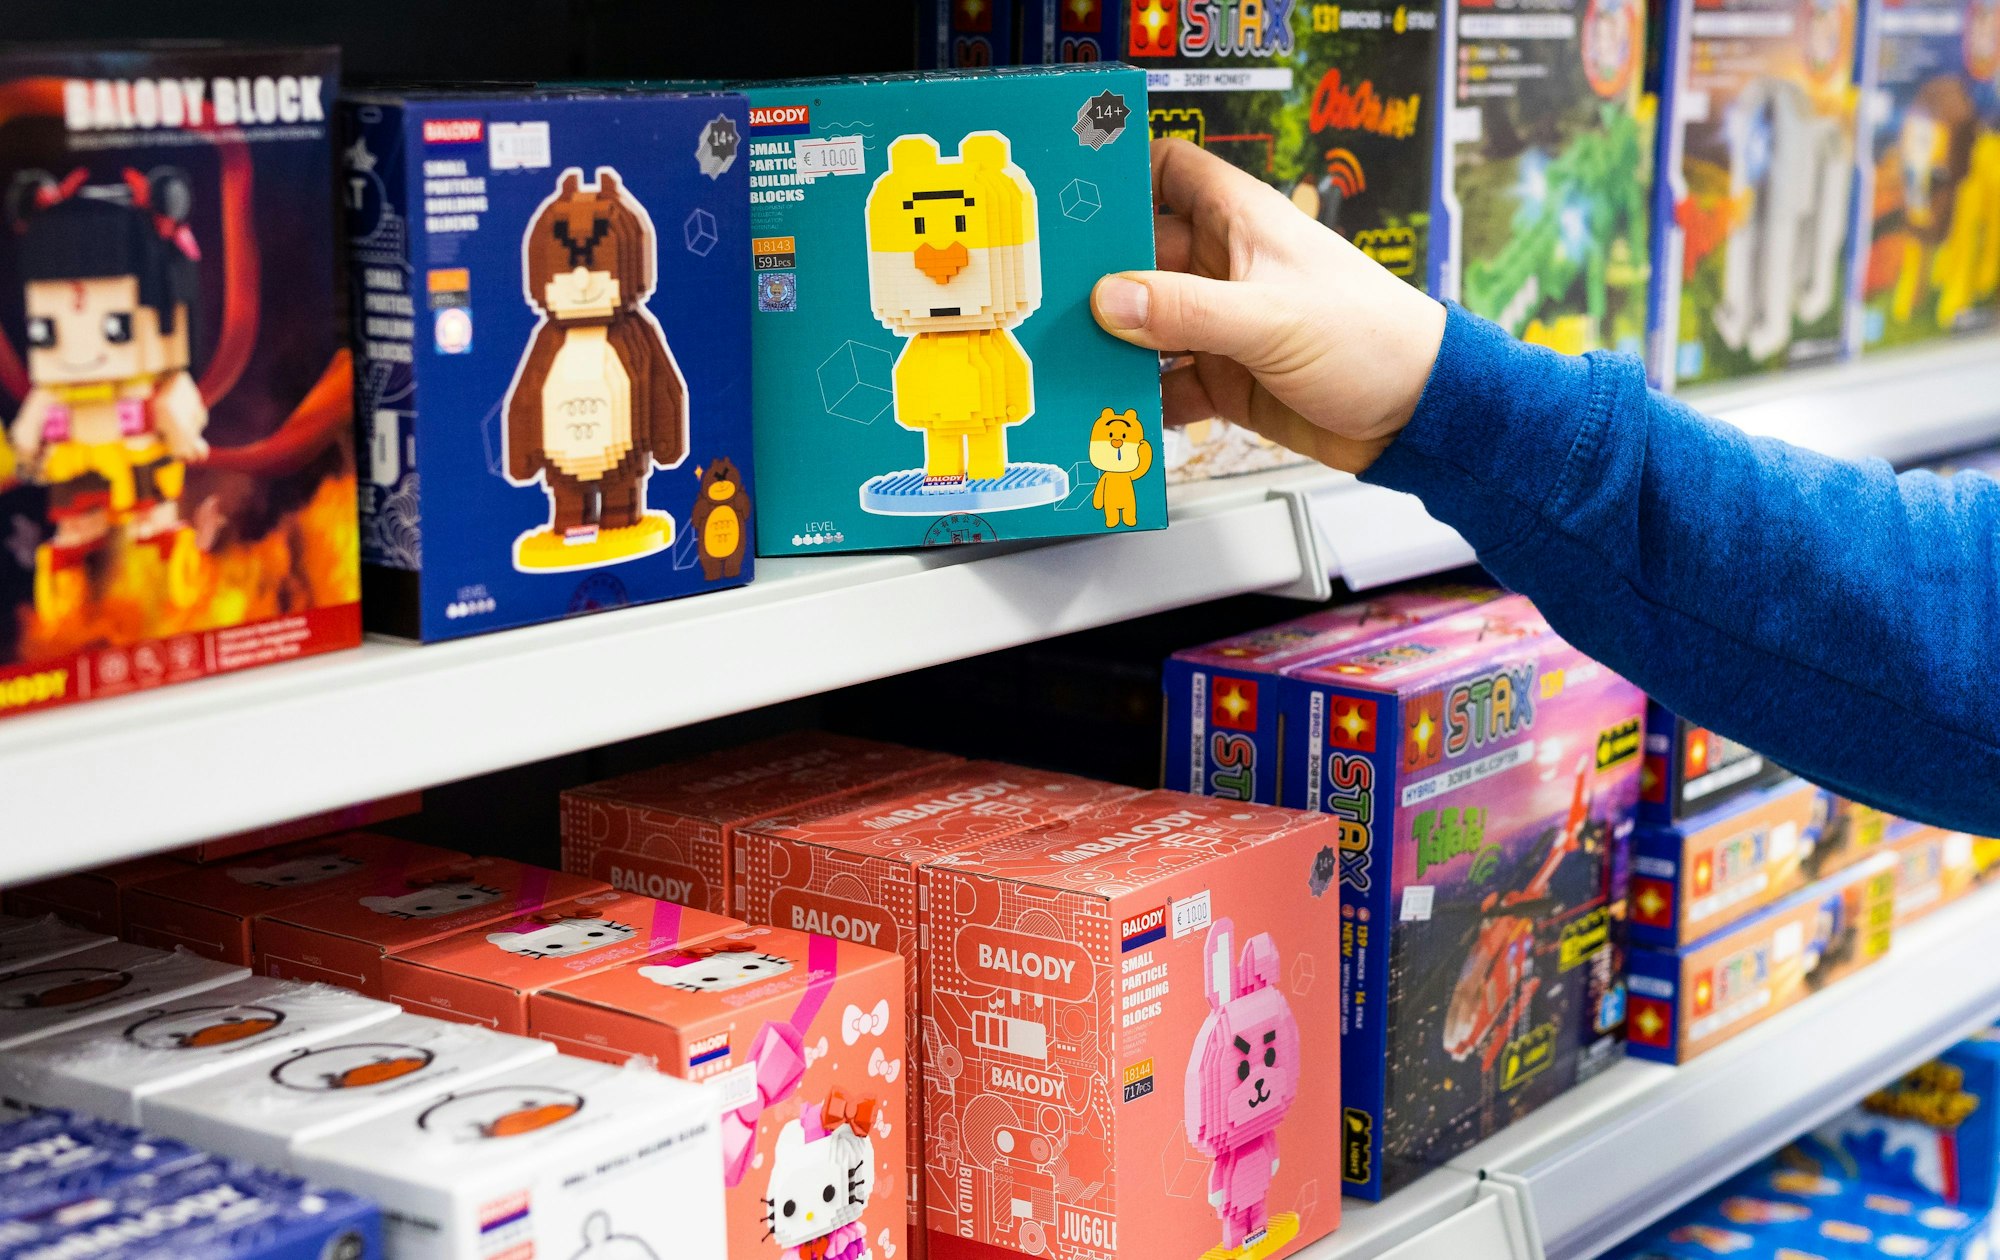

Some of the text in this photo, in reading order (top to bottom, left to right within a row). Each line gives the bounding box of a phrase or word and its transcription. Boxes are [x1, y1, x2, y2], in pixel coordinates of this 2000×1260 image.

[212, 76, 325, 124] BLOCK
[1094, 104, 1123, 119] 14+
[747, 107, 807, 124] BALODY
[713, 130, 735, 147] 14+
[748, 142, 792, 155] SMALL
[803, 147, 858, 167] € 10.00
[749, 188, 805, 204] BLOCKS
[757, 239, 791, 253] 18143
[758, 255, 792, 269] 591PCS
[805, 521, 836, 532] LEVEL
[1311, 696, 1321, 738] HYBRID
[1446, 658, 1538, 758] STAX
[1405, 780, 1438, 801] HYBRID
[1075, 810, 1207, 853] BALODY
[1328, 751, 1375, 892] STAX
[610, 865, 694, 905] BALODY
[791, 905, 882, 946] BALODY
[1122, 908, 1164, 938] BALODY
[1342, 921, 1353, 957] NEW
[978, 943, 1076, 985] BALODY
[1121, 950, 1154, 974] SMALL
[1122, 962, 1168, 992] PARTICLE
[1122, 980, 1169, 1010] BUILDING
[1123, 1001, 1162, 1028] BLOCKS
[991, 1066, 1065, 1100] BALODY
[1124, 1062, 1151, 1083] 18144
[1349, 1141, 1359, 1175] LIGHT
[959, 1166, 973, 1213] BUILD
